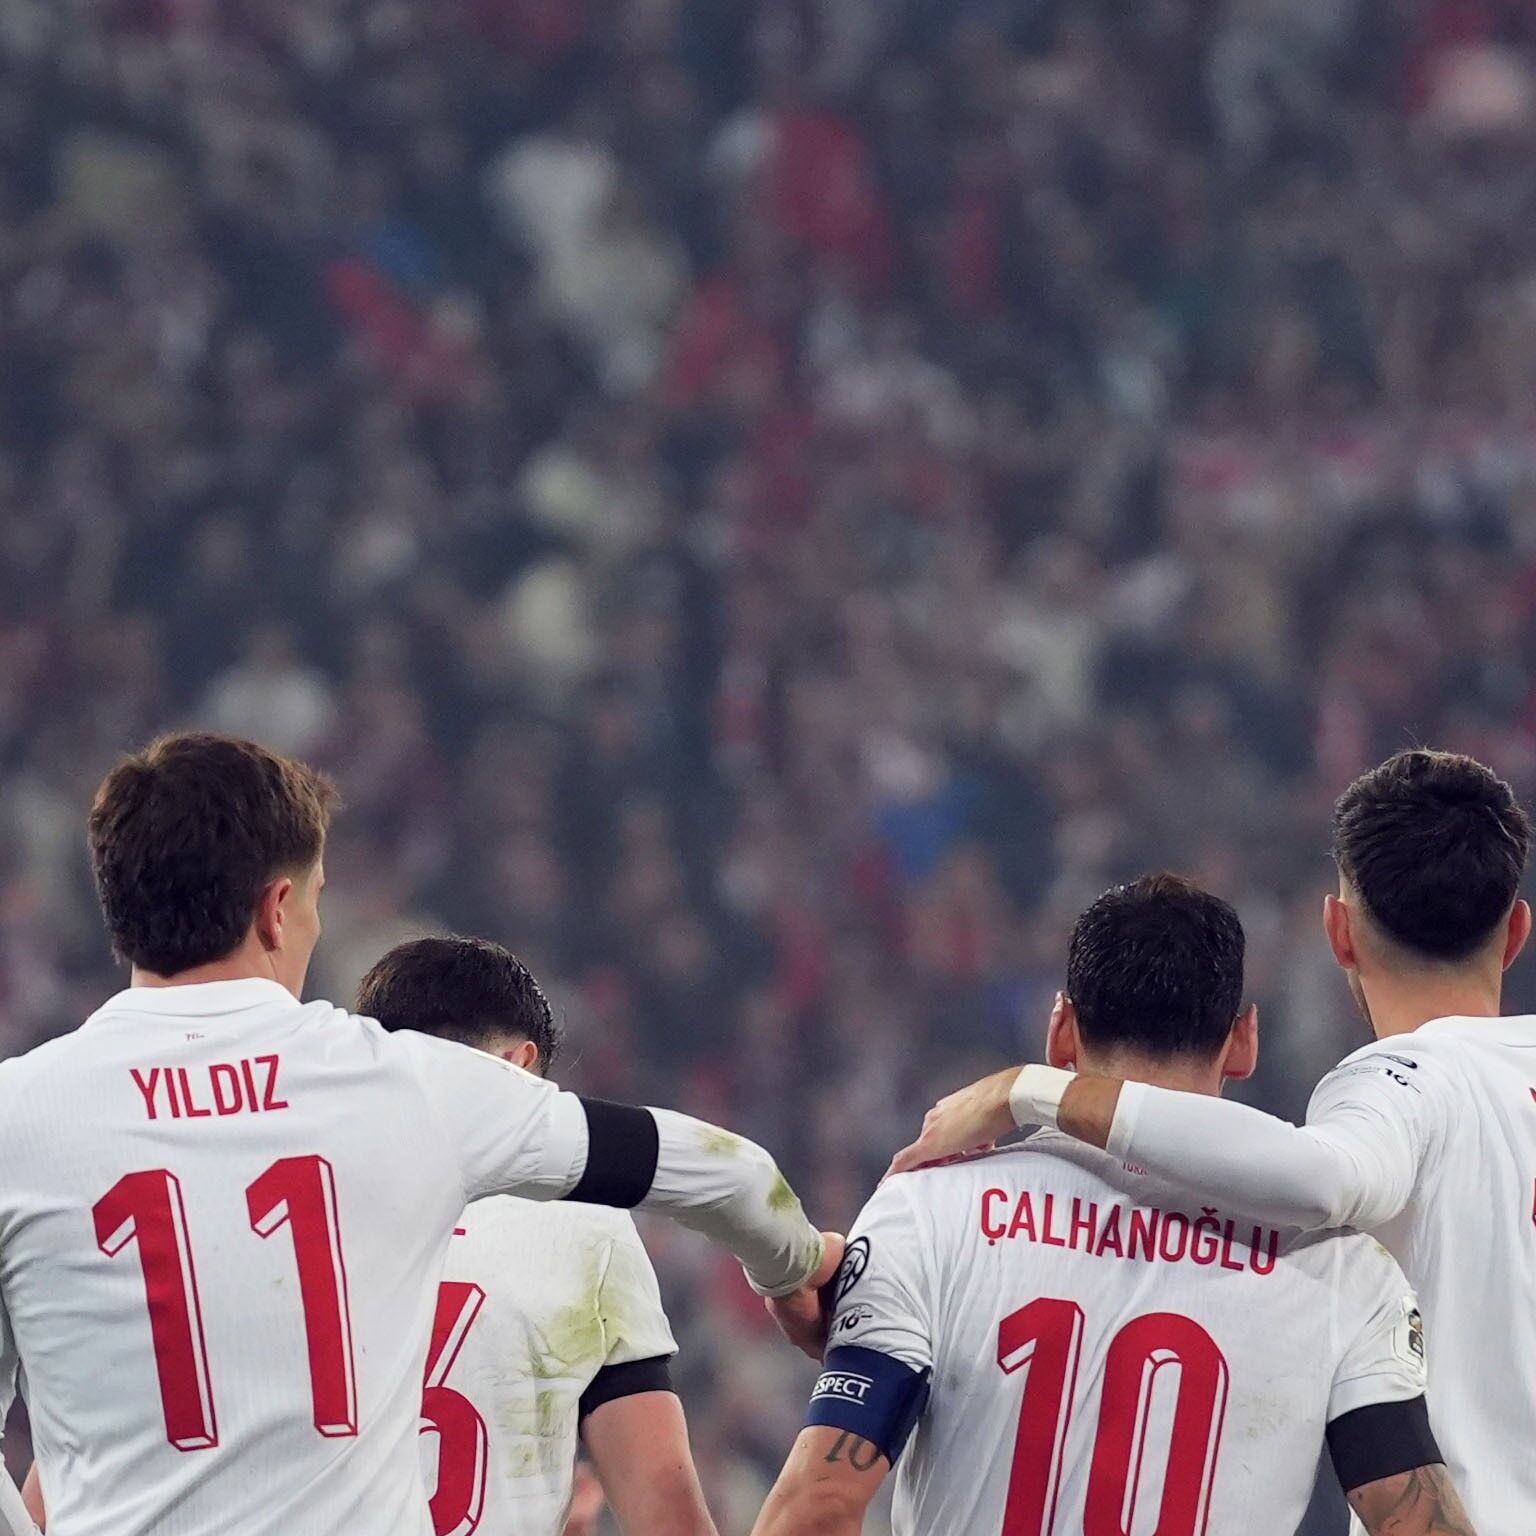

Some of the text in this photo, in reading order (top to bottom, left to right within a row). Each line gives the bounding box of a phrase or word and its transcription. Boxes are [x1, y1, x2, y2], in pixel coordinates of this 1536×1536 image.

[130, 1054, 290, 1121] YILDIZ
[980, 1187, 1281, 1277] ÇALHANOĞLU
[92, 1154, 360, 1453] 11
[812, 1377, 872, 1398] ESPECT
